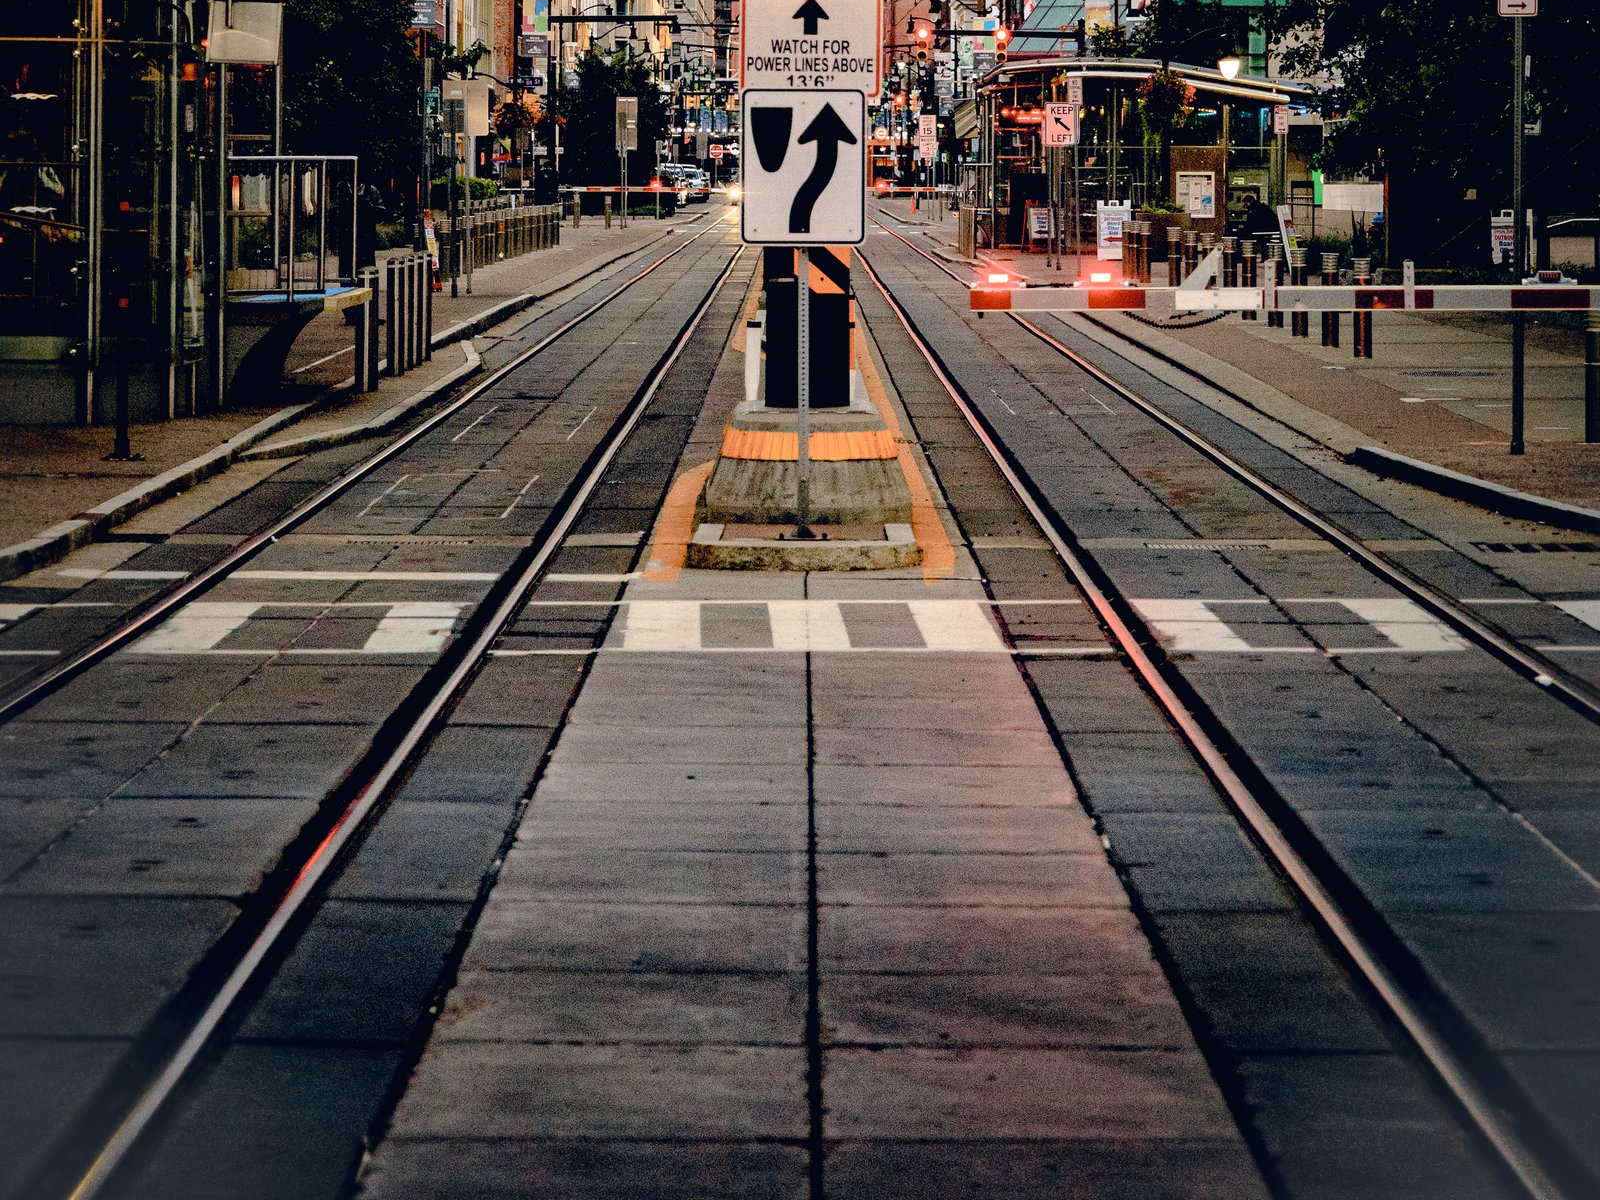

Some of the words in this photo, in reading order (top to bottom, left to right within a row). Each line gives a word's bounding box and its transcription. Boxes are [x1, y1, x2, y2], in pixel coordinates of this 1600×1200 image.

[771, 39, 818, 54] WATCH
[823, 40, 850, 54] FOR
[747, 57, 790, 72] POWER
[795, 58, 829, 73] LINES
[832, 58, 873, 73] ABOVE
[1050, 106, 1074, 115] KEEP
[923, 127, 933, 135] 15
[1051, 134, 1073, 143] LEFT
